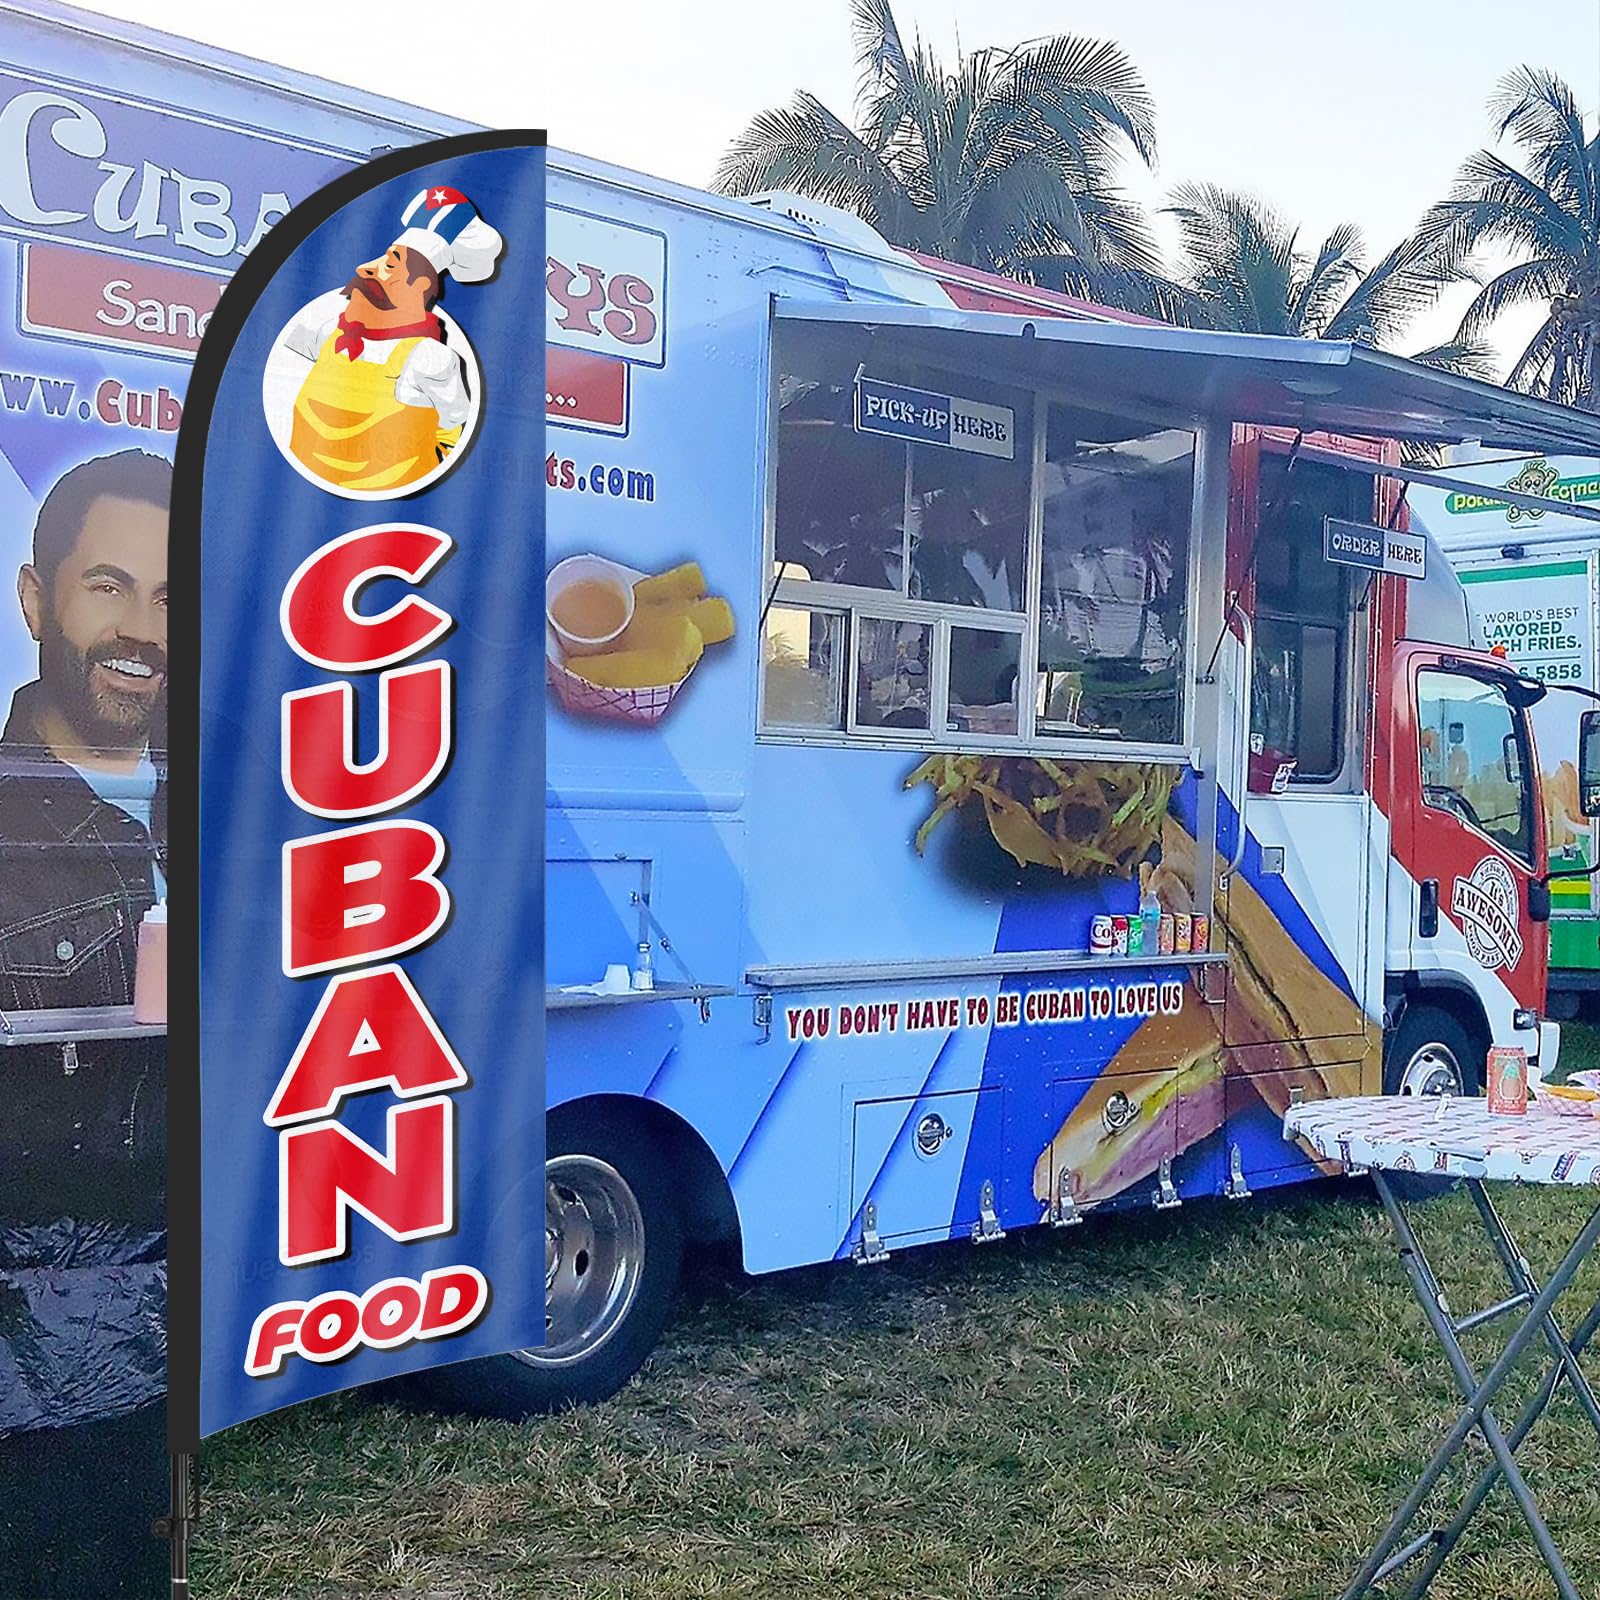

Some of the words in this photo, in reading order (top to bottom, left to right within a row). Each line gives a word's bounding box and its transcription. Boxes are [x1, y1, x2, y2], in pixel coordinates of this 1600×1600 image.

[865, 394, 949, 431] PICK-UP
[952, 412, 1007, 442] HERE
[1332, 533, 1381, 557] ORDER
[1387, 541, 1422, 564] HERE
[1484, 609, 1543, 623] WORLD'S
[1547, 606, 1579, 620] BEST
[1528, 634, 1582, 652] FRIES.
[1536, 663, 1582, 681] 5858
[263, 522, 468, 1267] CUBAN
[1489, 880, 1504, 907] It's
[1455, 886, 1519, 962] AWESOME
[787, 1008, 830, 1039] YOU
[839, 1003, 898, 1035] DON'T
[906, 999, 959, 1031] HAVE
[967, 998, 988, 1026] TO
[996, 995, 1019, 1024] BE
[1026, 990, 1084, 1022] CUBAN
[1091, 989, 1110, 1017] TO
[1117, 986, 1156, 1014] LOVE
[1162, 985, 1182, 1011] US
[244, 1265, 488, 1377] FOOD
